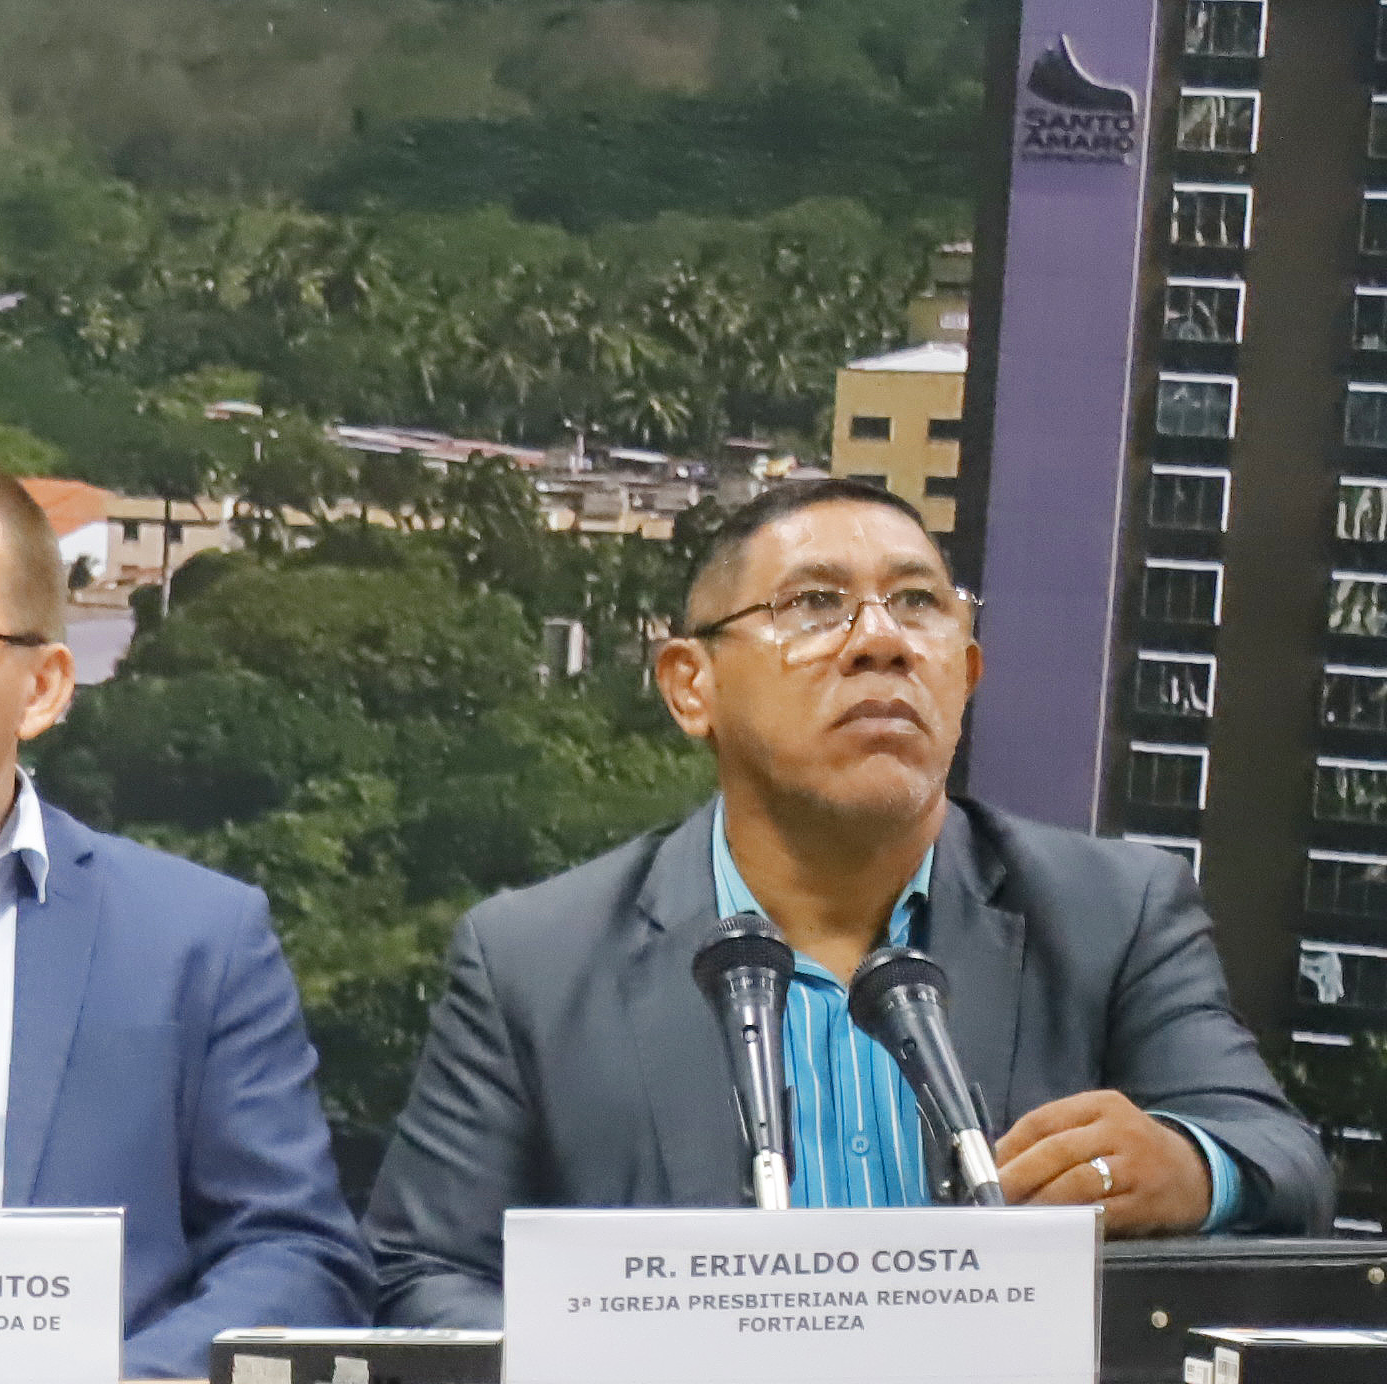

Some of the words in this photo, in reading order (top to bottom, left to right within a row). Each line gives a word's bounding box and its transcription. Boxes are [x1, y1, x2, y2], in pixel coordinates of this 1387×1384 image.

[1024, 107, 1134, 132] SANTO
[1025, 129, 1134, 153] AMARO
[625, 1256, 676, 1279] PR.
[690, 1251, 860, 1278] ERIVALDO
[871, 1248, 980, 1273] COSTA
[568, 1297, 591, 1313] 3ª
[600, 1295, 681, 1313] IGREJA
[688, 1290, 869, 1310] PRESBITERIANA
[877, 1288, 999, 1306] RENOVADA
[1007, 1287, 1036, 1303] DE
[33, 1315, 61, 1331] DE
[738, 1314, 865, 1333] FORTALEZA
